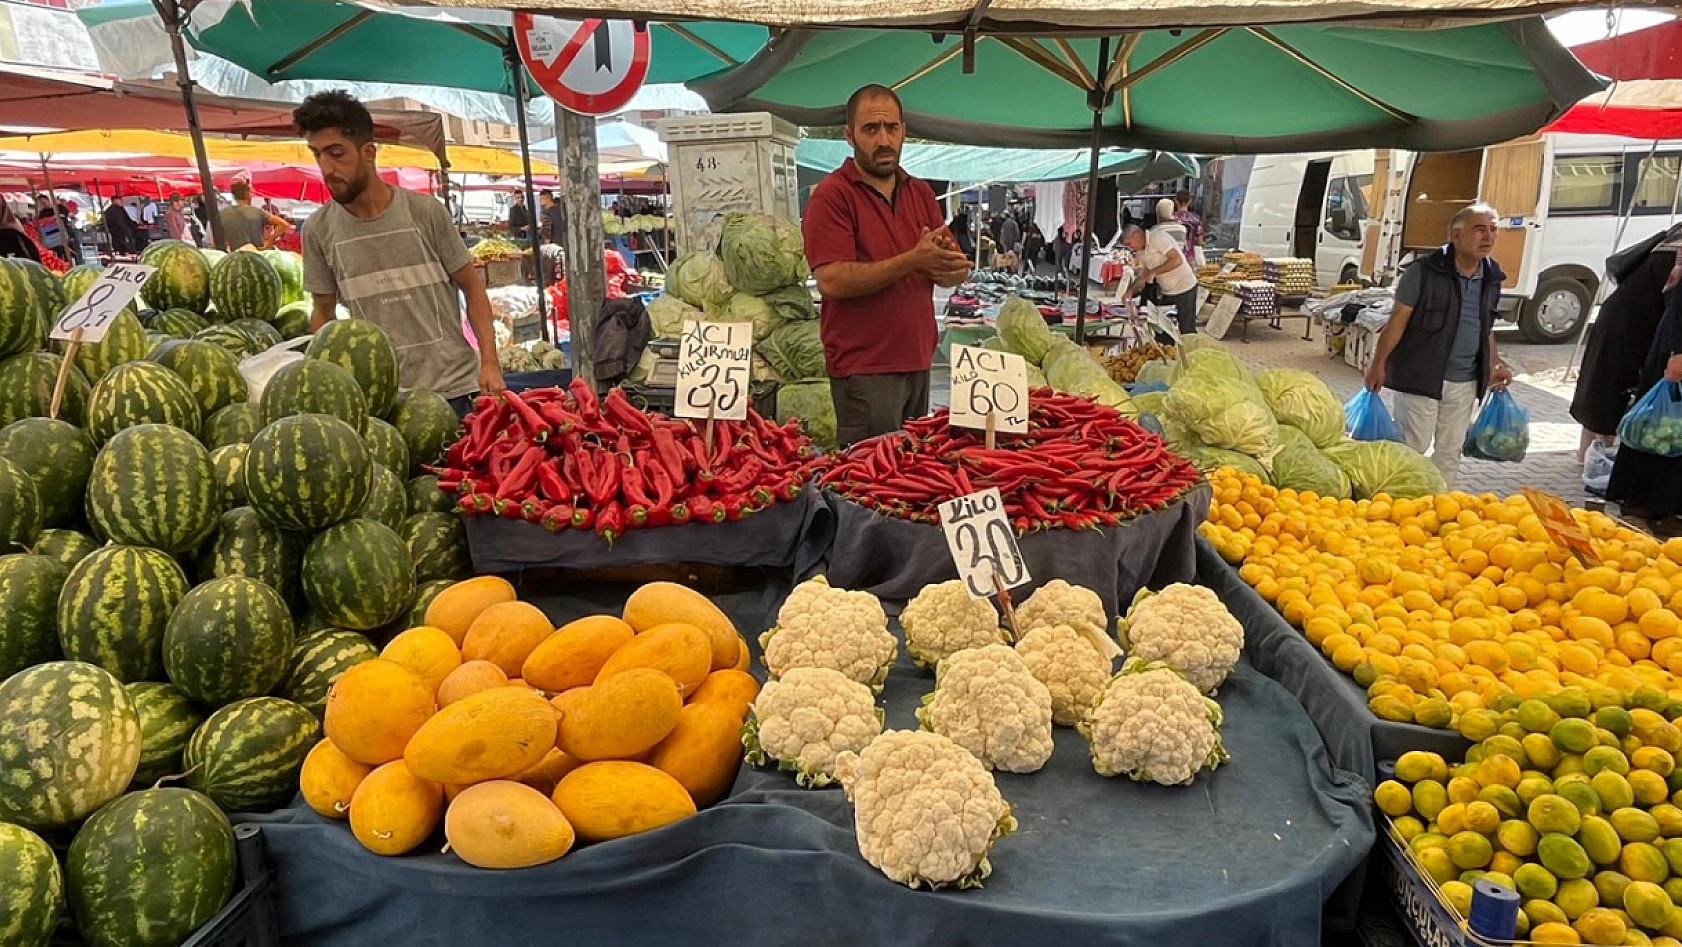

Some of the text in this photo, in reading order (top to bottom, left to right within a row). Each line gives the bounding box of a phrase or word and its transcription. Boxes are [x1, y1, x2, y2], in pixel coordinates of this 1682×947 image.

[682, 320, 733, 345] ACI
[956, 347, 1005, 371] ACI
[688, 364, 746, 411] 35
